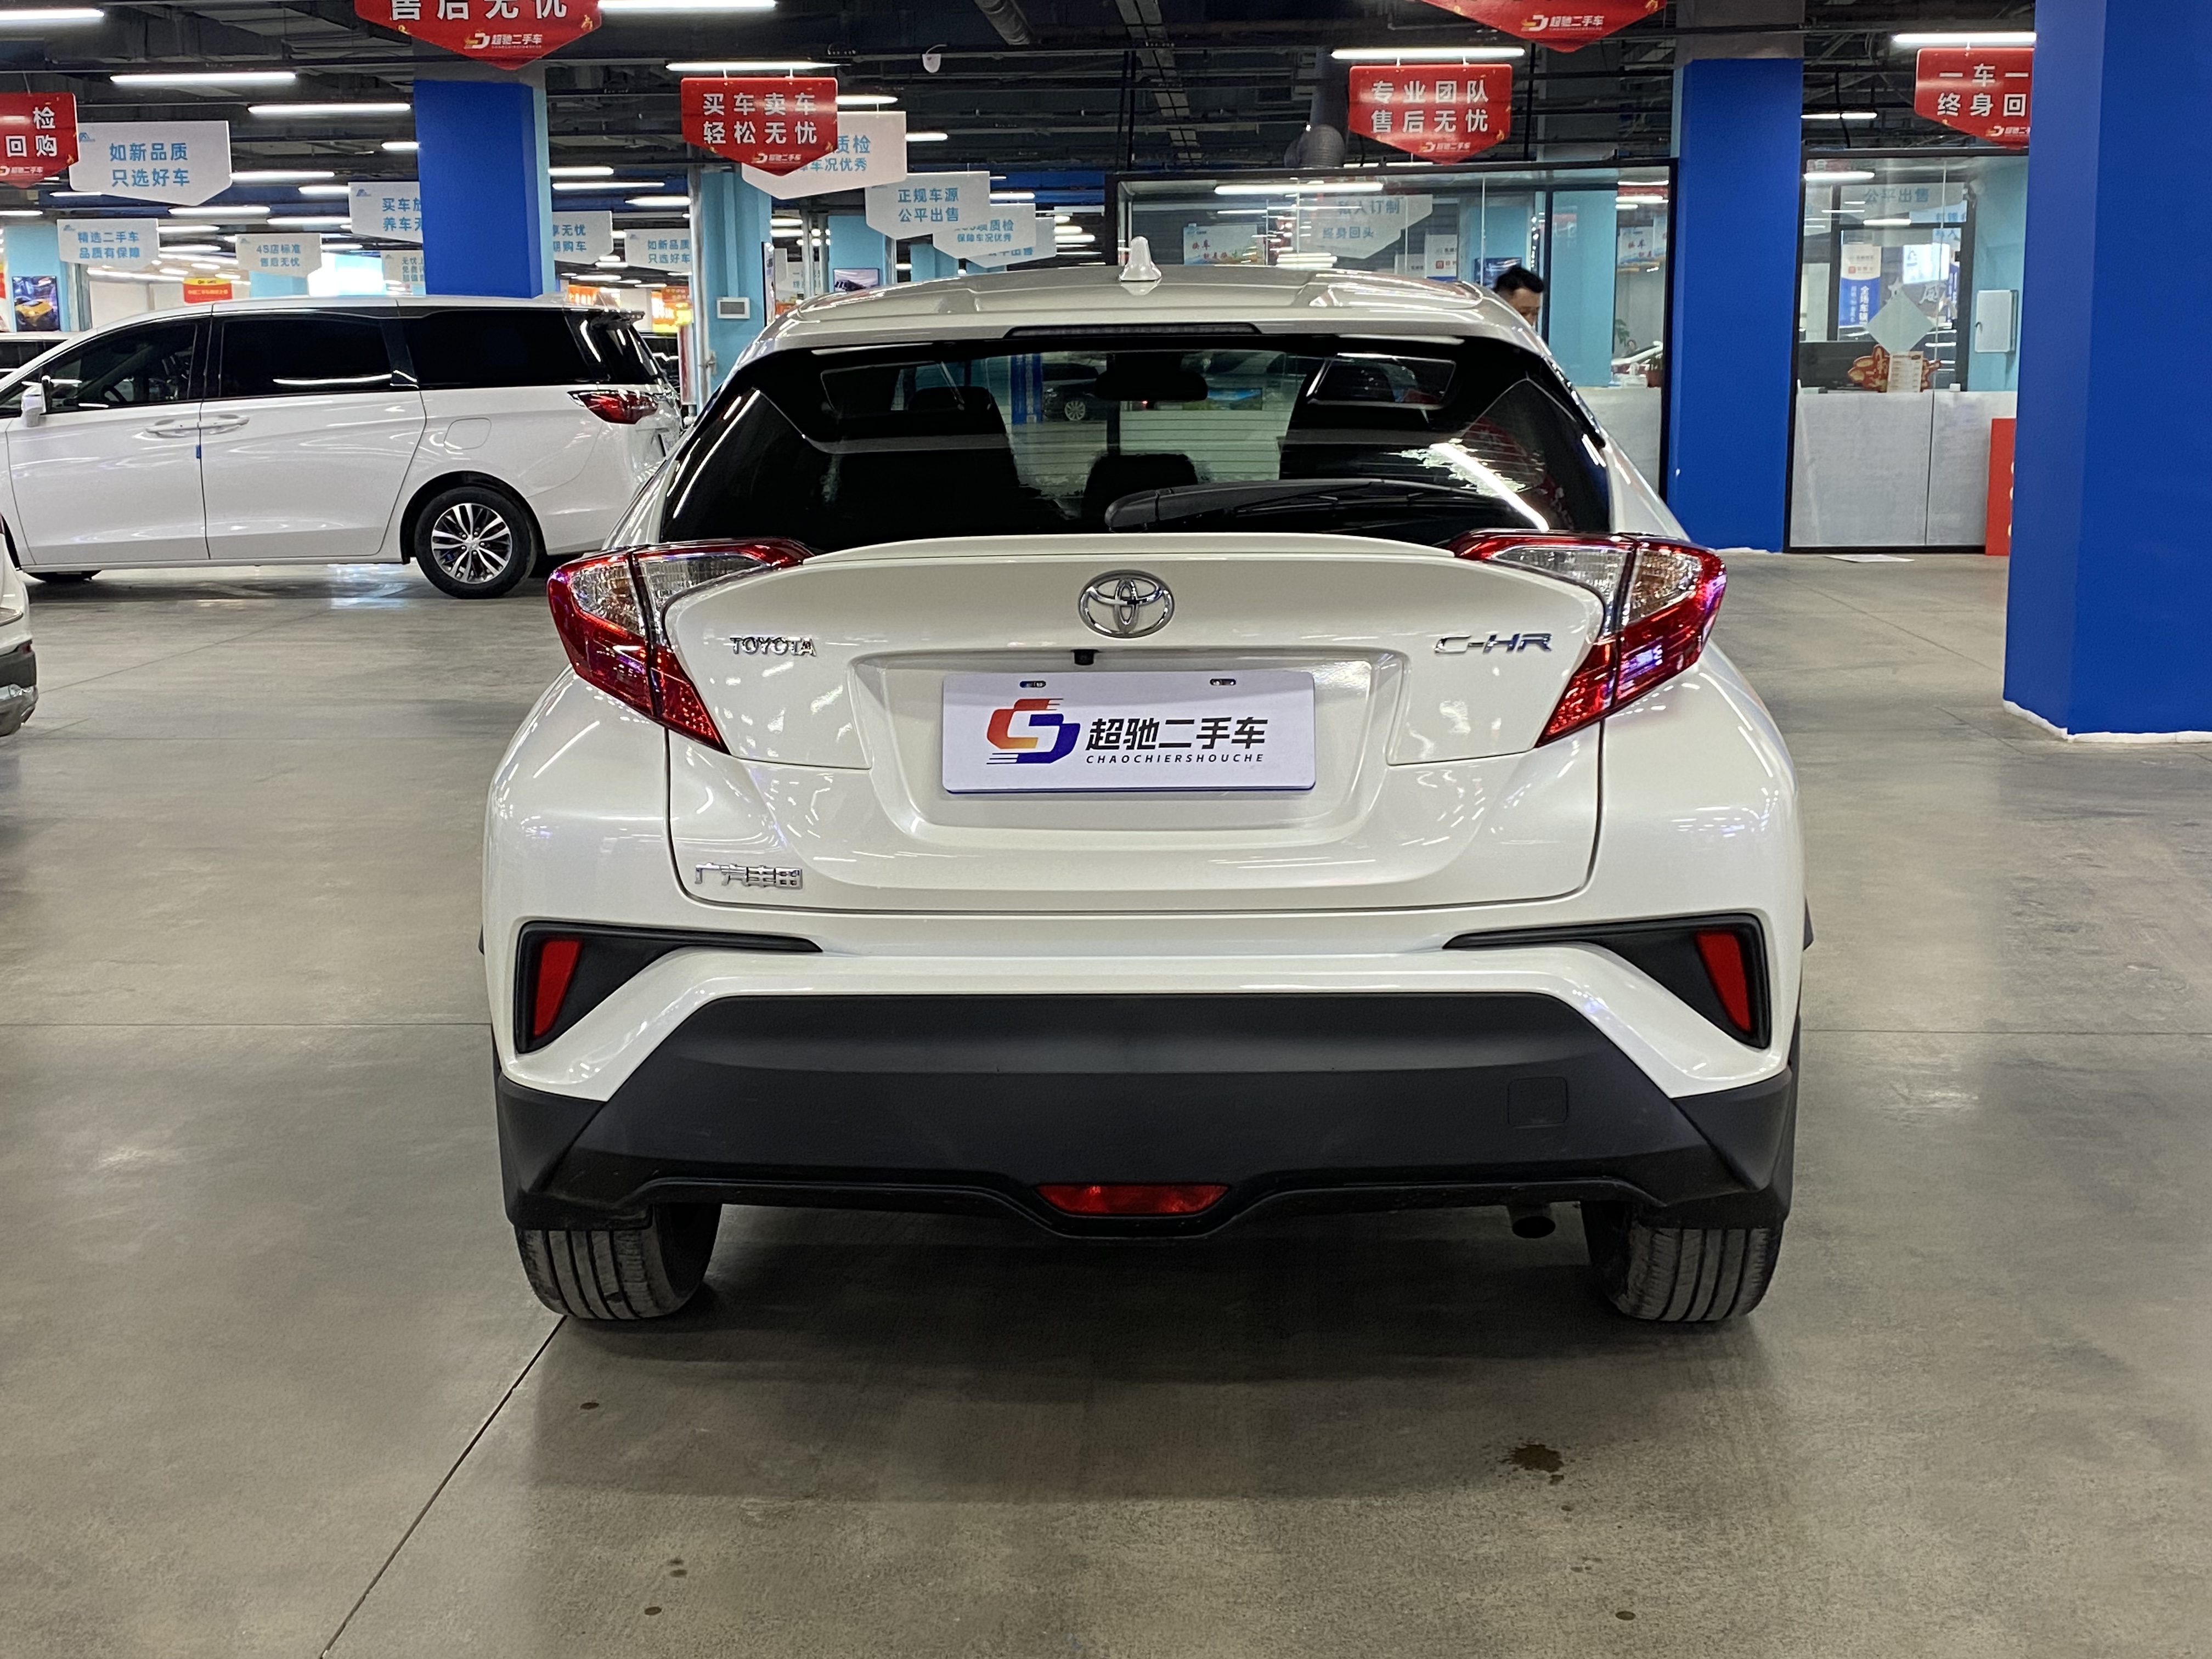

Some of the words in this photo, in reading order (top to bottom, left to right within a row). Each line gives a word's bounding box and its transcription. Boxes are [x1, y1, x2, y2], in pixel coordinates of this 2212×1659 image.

[391, 0, 567, 21] 售后无忧
[1939, 63, 2029, 87] 一车一
[1372, 80, 1488, 104] 专业团队
[703, 92, 816, 116] 买车卖车
[1937, 92, 2027, 117] 终身回
[1371, 109, 1488, 133] 售后无忧
[703, 121, 817, 144] 轻松无忧
[5, 134, 57, 157] 回购
[110, 142, 188, 161] 如新品质
[111, 168, 190, 187] 只选好车
[898, 188, 959, 203] 正规车源
[899, 208, 959, 222] 公平出售
[78, 232, 139, 243] 精选二手车
[648, 240, 690, 250] 如新品质
[80, 247, 140, 259] 品质有保障
[256, 244, 301, 253] 4S店标准
[648, 253, 690, 264] 只选好车
[261, 257, 300, 267] 售后无忧
[730, 636, 817, 657] TOYOTA
[1434, 633, 1552, 654] C-HR
[1085, 717, 1268, 751] 超驰二手车
[1086, 754, 1263, 764] CHAOCHIERSHOUCHE
